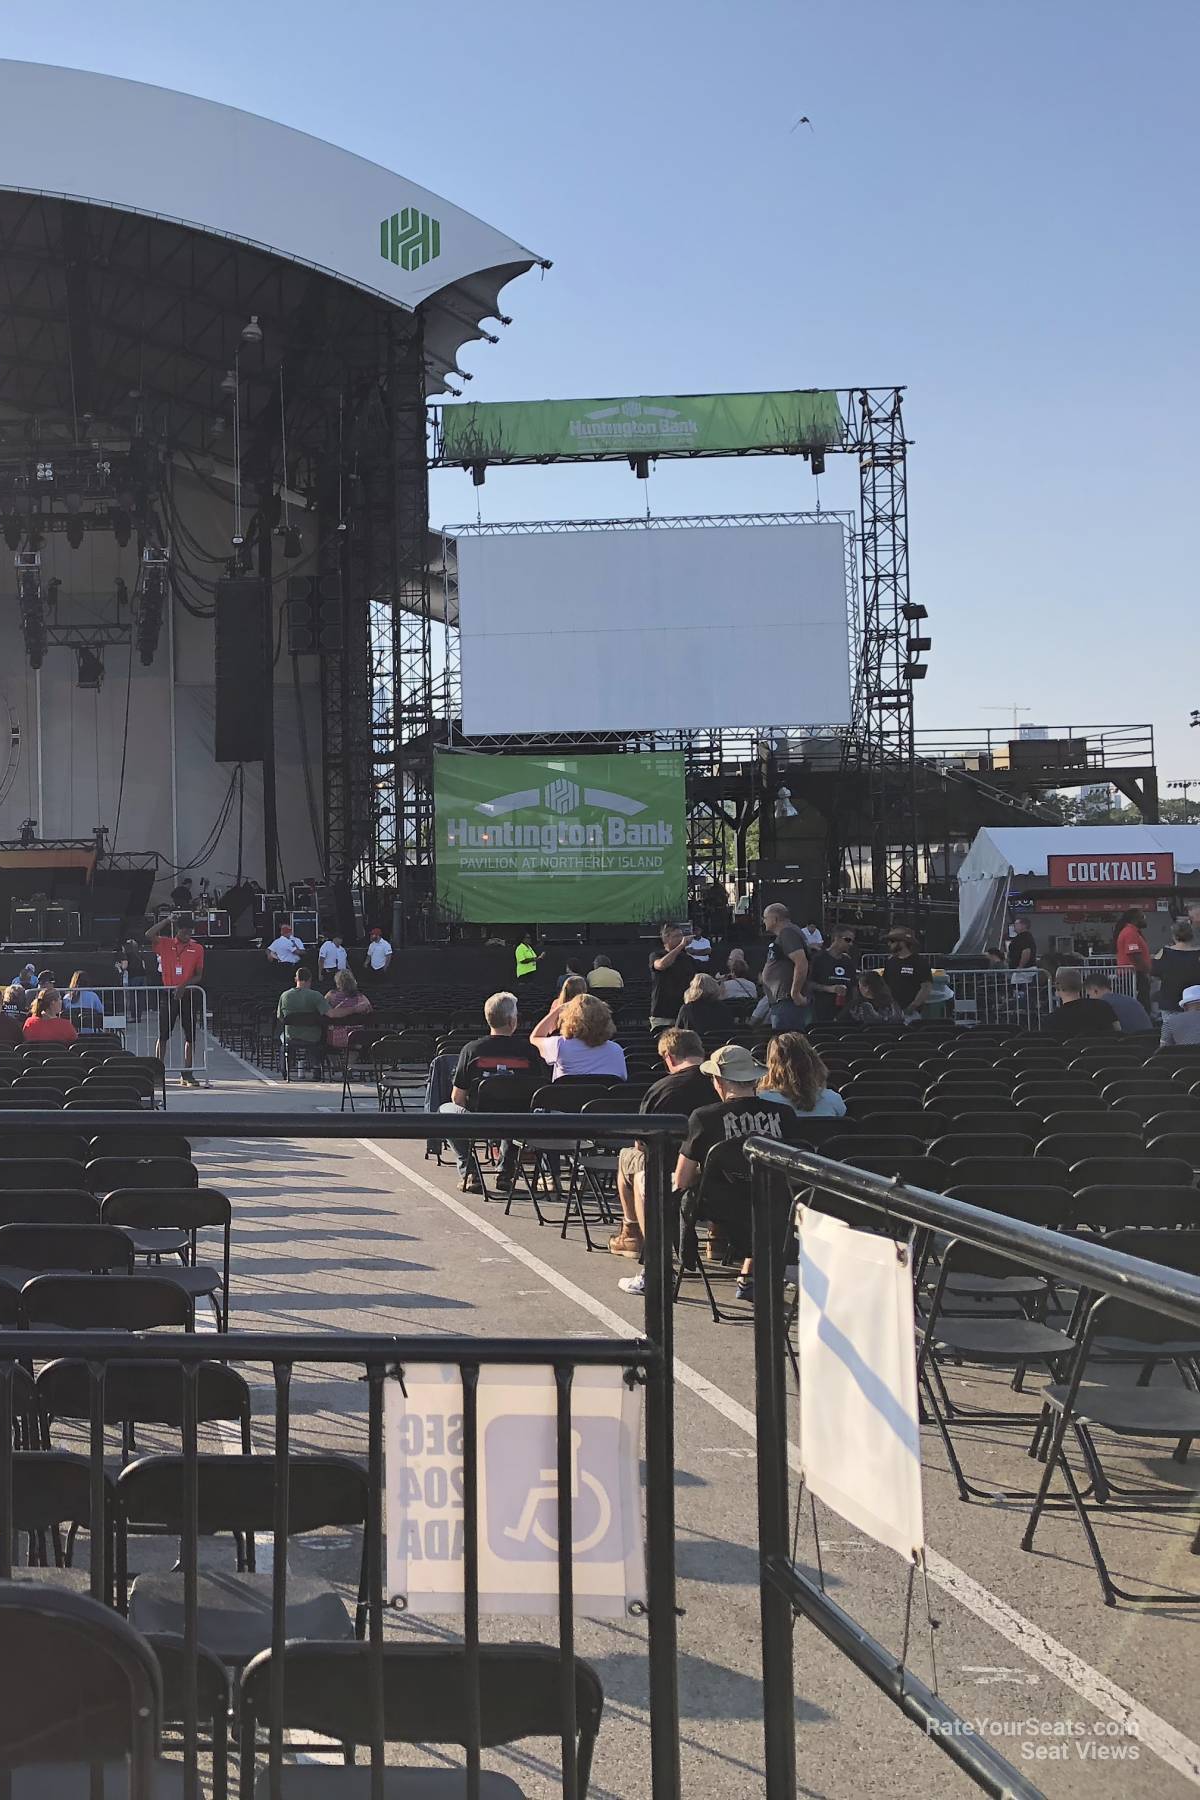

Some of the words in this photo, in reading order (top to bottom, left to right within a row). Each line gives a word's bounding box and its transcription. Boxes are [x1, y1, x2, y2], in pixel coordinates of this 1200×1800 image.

[448, 818, 603, 854] Huntington
[608, 816, 673, 846] Bank
[460, 857, 517, 869] PAVILION
[522, 857, 538, 868] AT
[540, 856, 615, 868] NORTHERLY
[618, 856, 663, 868] ISLAND
[1067, 861, 1158, 882] COCKTAILS
[722, 1111, 783, 1141] ROCK
